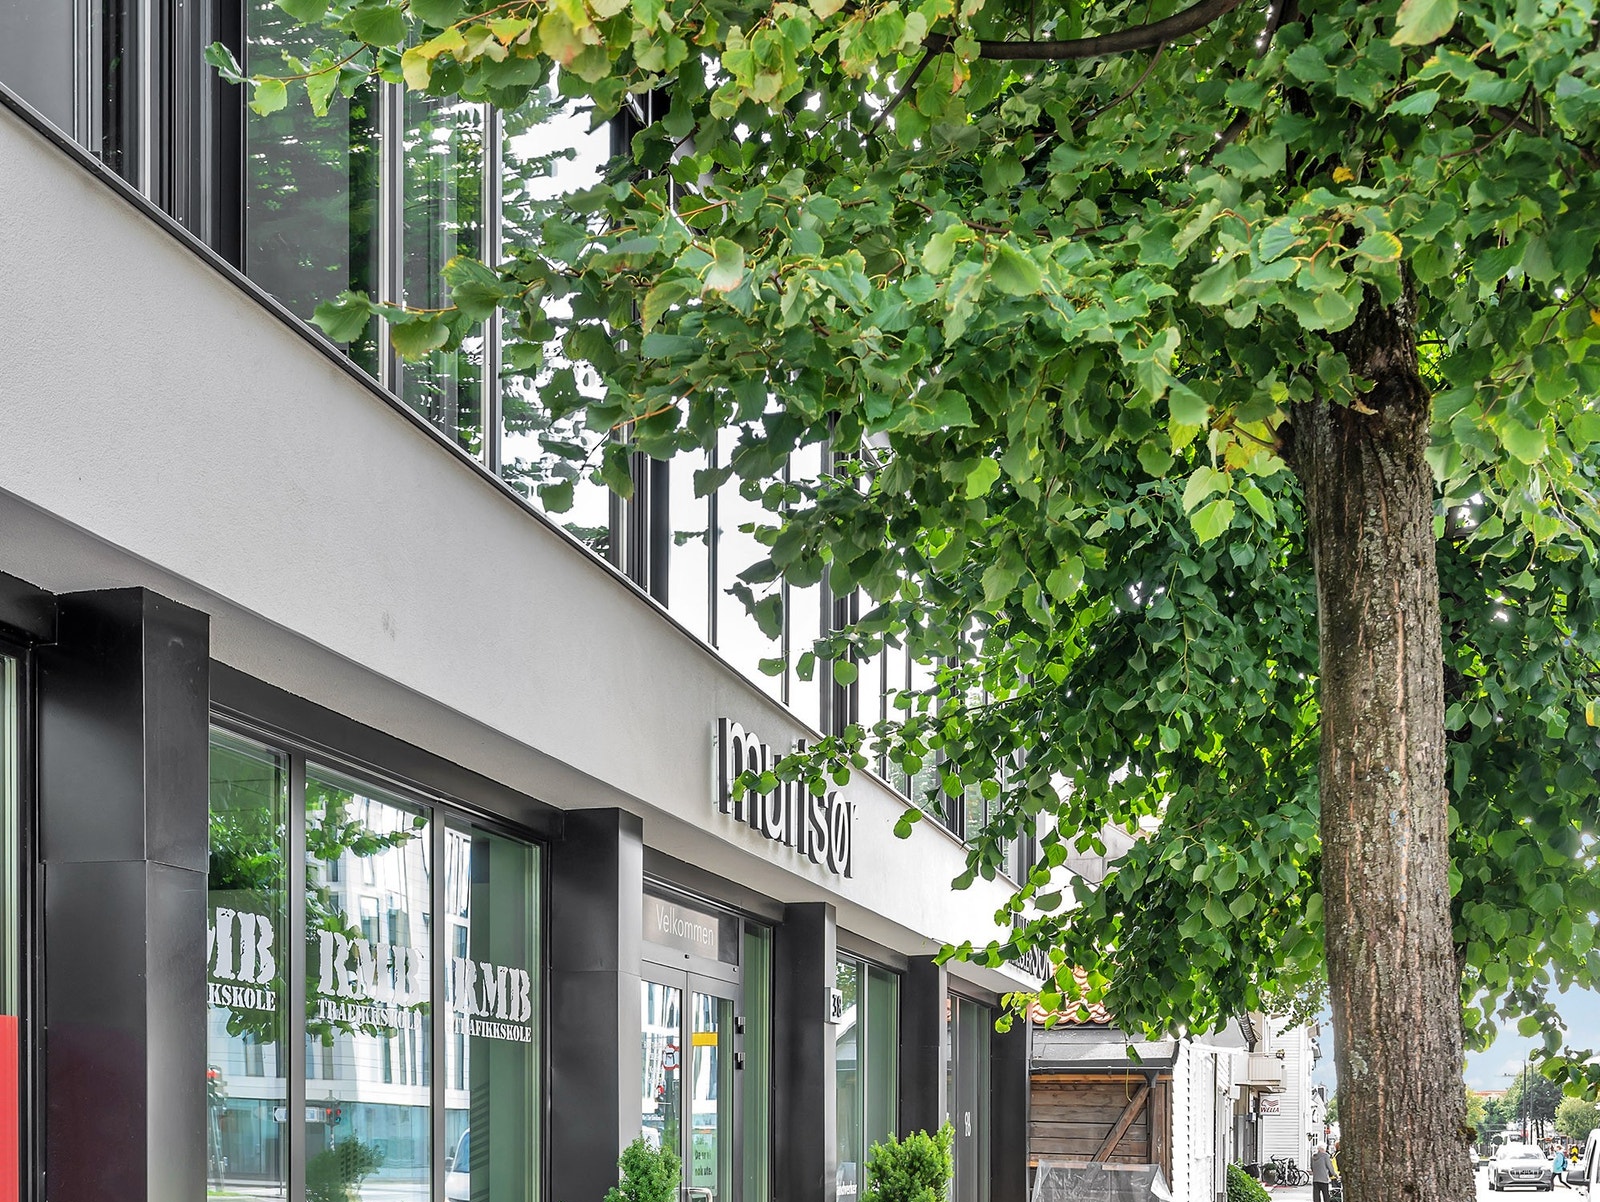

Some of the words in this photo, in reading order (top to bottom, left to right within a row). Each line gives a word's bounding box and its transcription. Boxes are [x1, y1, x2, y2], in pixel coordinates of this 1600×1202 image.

[655, 903, 714, 946] Velkommen
[316, 928, 419, 1007] RMB
[207, 982, 276, 1012] KSKOLE
[452, 956, 531, 1023] RMB
[317, 999, 422, 1030] TRAFIKKSKOLE
[832, 994, 842, 1018] 38
[454, 1018, 532, 1042] TRAFIKKSKOLE
